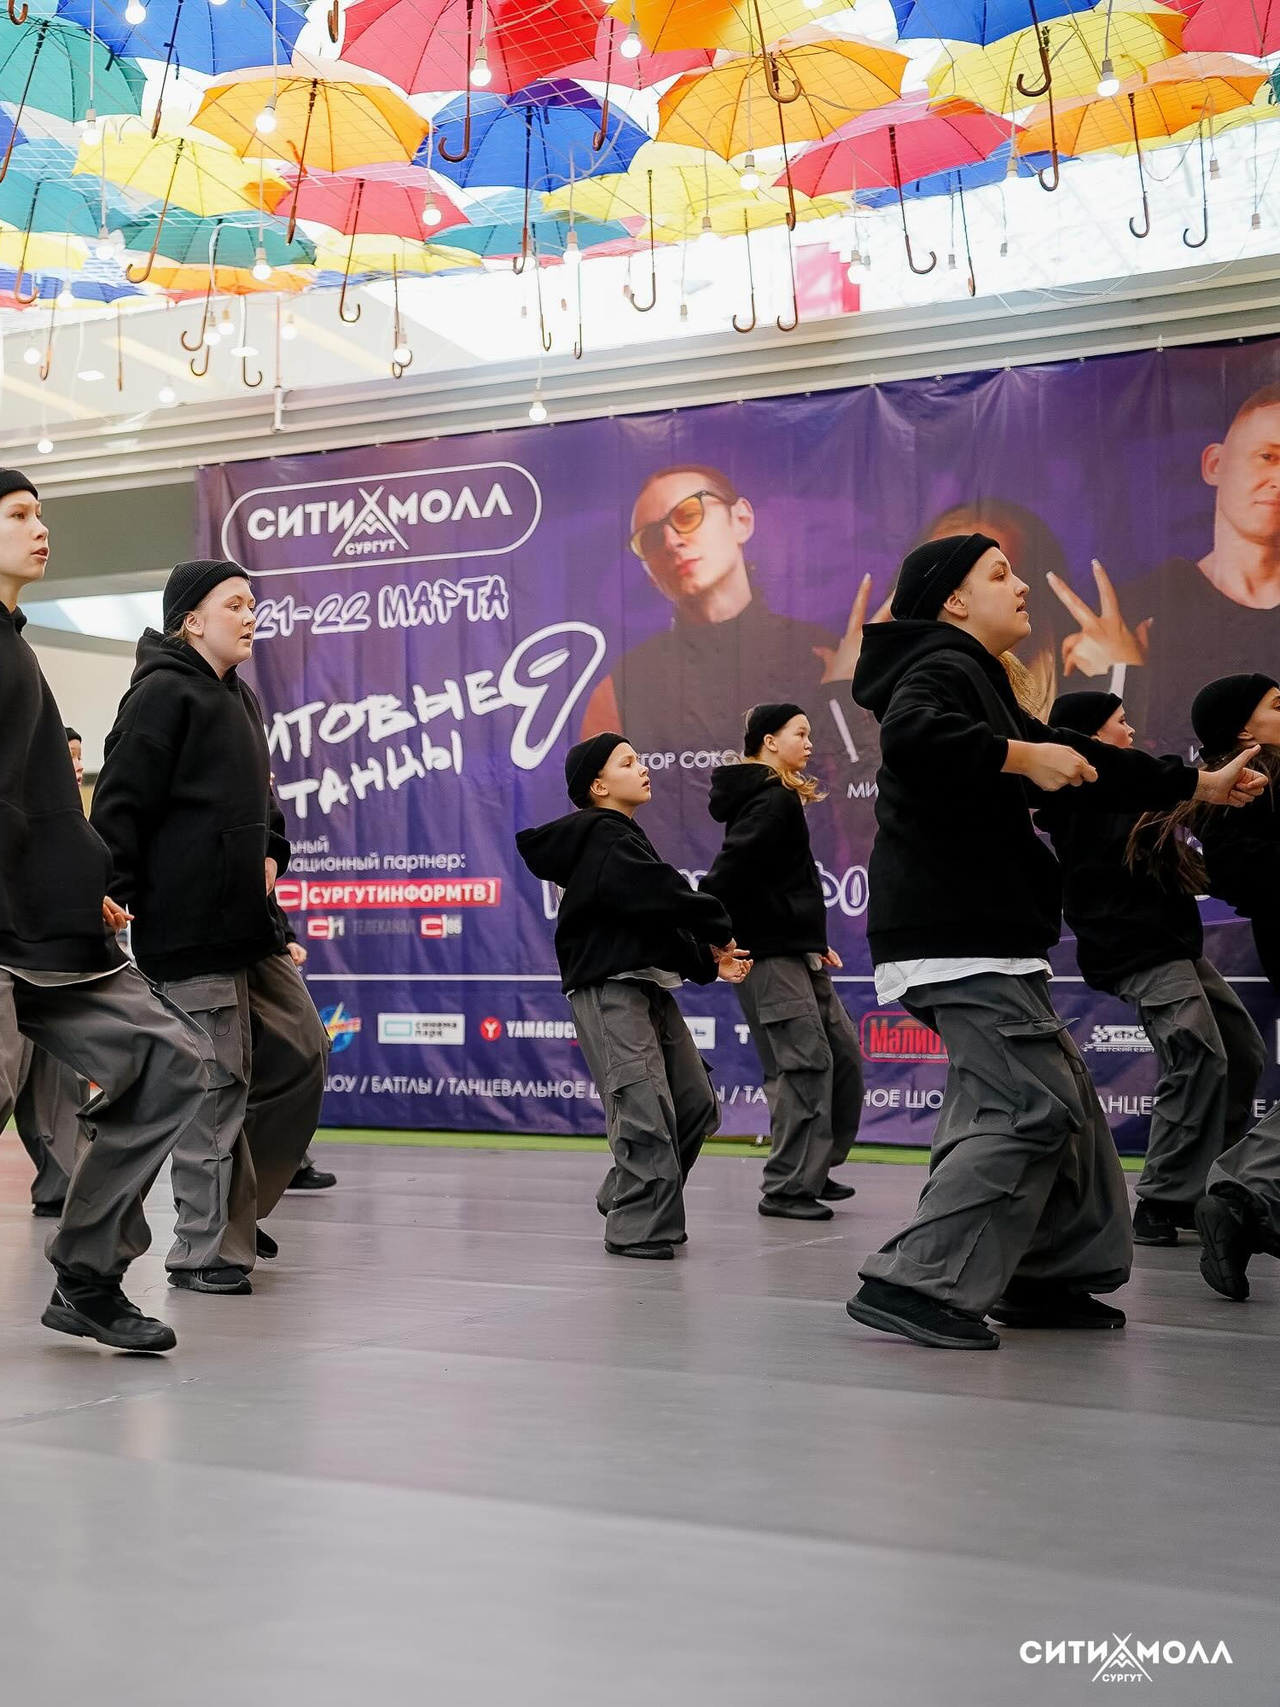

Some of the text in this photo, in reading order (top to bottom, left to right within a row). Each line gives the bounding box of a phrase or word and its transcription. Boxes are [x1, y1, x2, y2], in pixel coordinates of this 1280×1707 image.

[344, 538, 397, 556] СУРГУТ
[378, 574, 510, 629] МАРТА
[277, 729, 463, 819] ТАНЦЫ
[383, 853, 466, 873] партнер:
[447, 1076, 587, 1099] ТАНЦЕВАЛЬНОЕ
